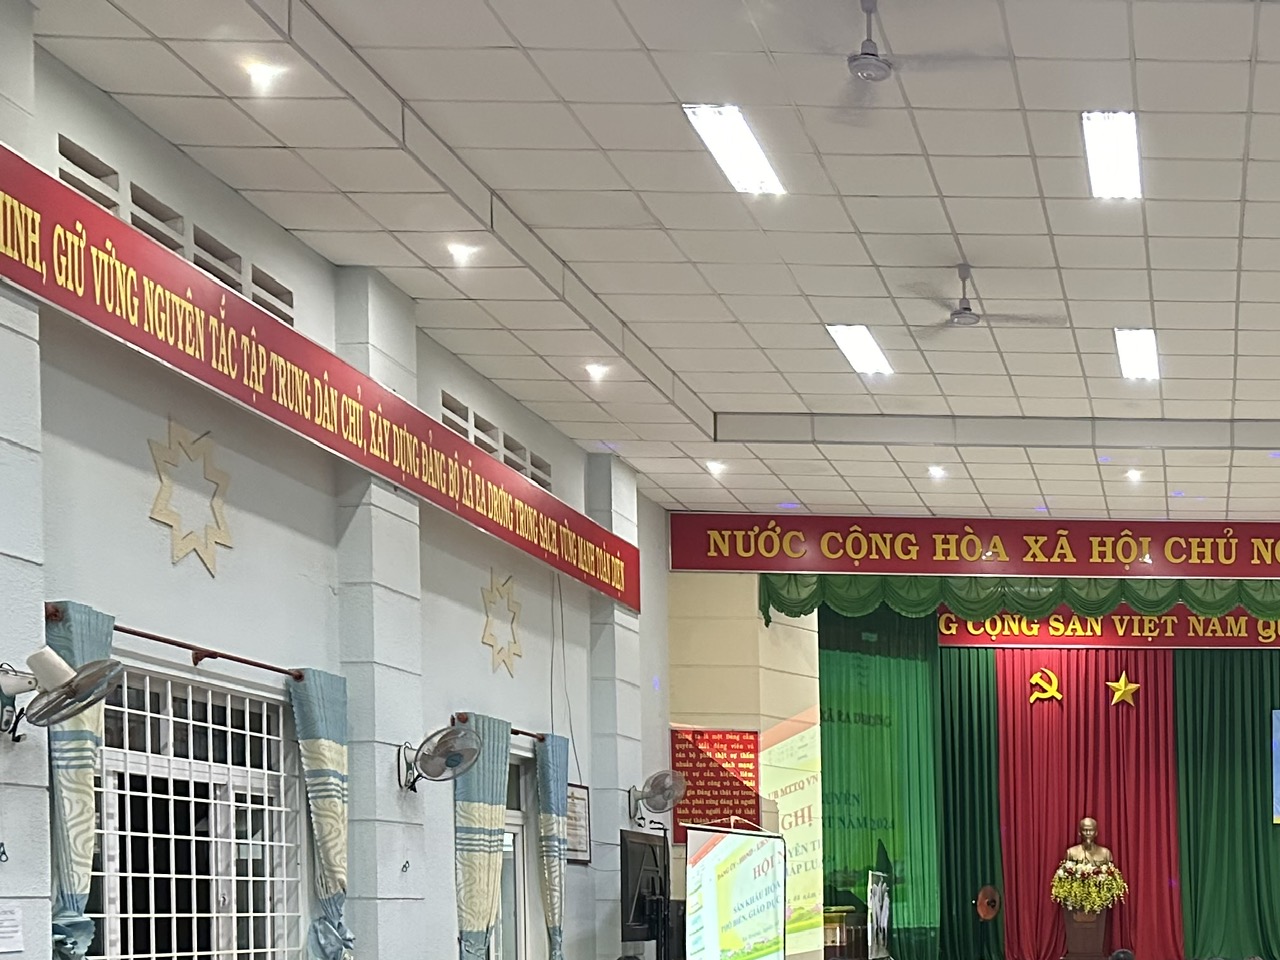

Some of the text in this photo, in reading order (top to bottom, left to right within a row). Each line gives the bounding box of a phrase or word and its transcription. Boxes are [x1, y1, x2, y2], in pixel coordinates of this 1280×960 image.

[0, 190, 46, 285] INH,
[53, 220, 86, 297] GIỮ
[90, 238, 139, 327] VỮNG
[143, 287, 205, 362] NGUYÊN
[209, 294, 237, 380] TẮC
[241, 326, 267, 403] TẬP
[270, 351, 311, 421] TRUNG
[314, 370, 338, 434] DÂN
[341, 385, 367, 456] CHỦ,
[368, 403, 391, 463] XÂY
[392, 423, 419, 481] DỰNG
[421, 429, 446, 495] ĐẢNG
[448, 450, 460, 511] BỘ
[461, 459, 474, 510] XÃ
[475, 473, 487, 516] EA
[514, 498, 539, 546] TRONG
[707, 520, 807, 559] NƯỚC
[820, 524, 919, 567] CỘNG
[933, 525, 1008, 562] HÒA
[1023, 529, 1079, 563] XÃ
[1089, 529, 1152, 571] HỘI
[1164, 527, 1238, 566] CHỦ
[1187, 616, 1248, 637] NAM
